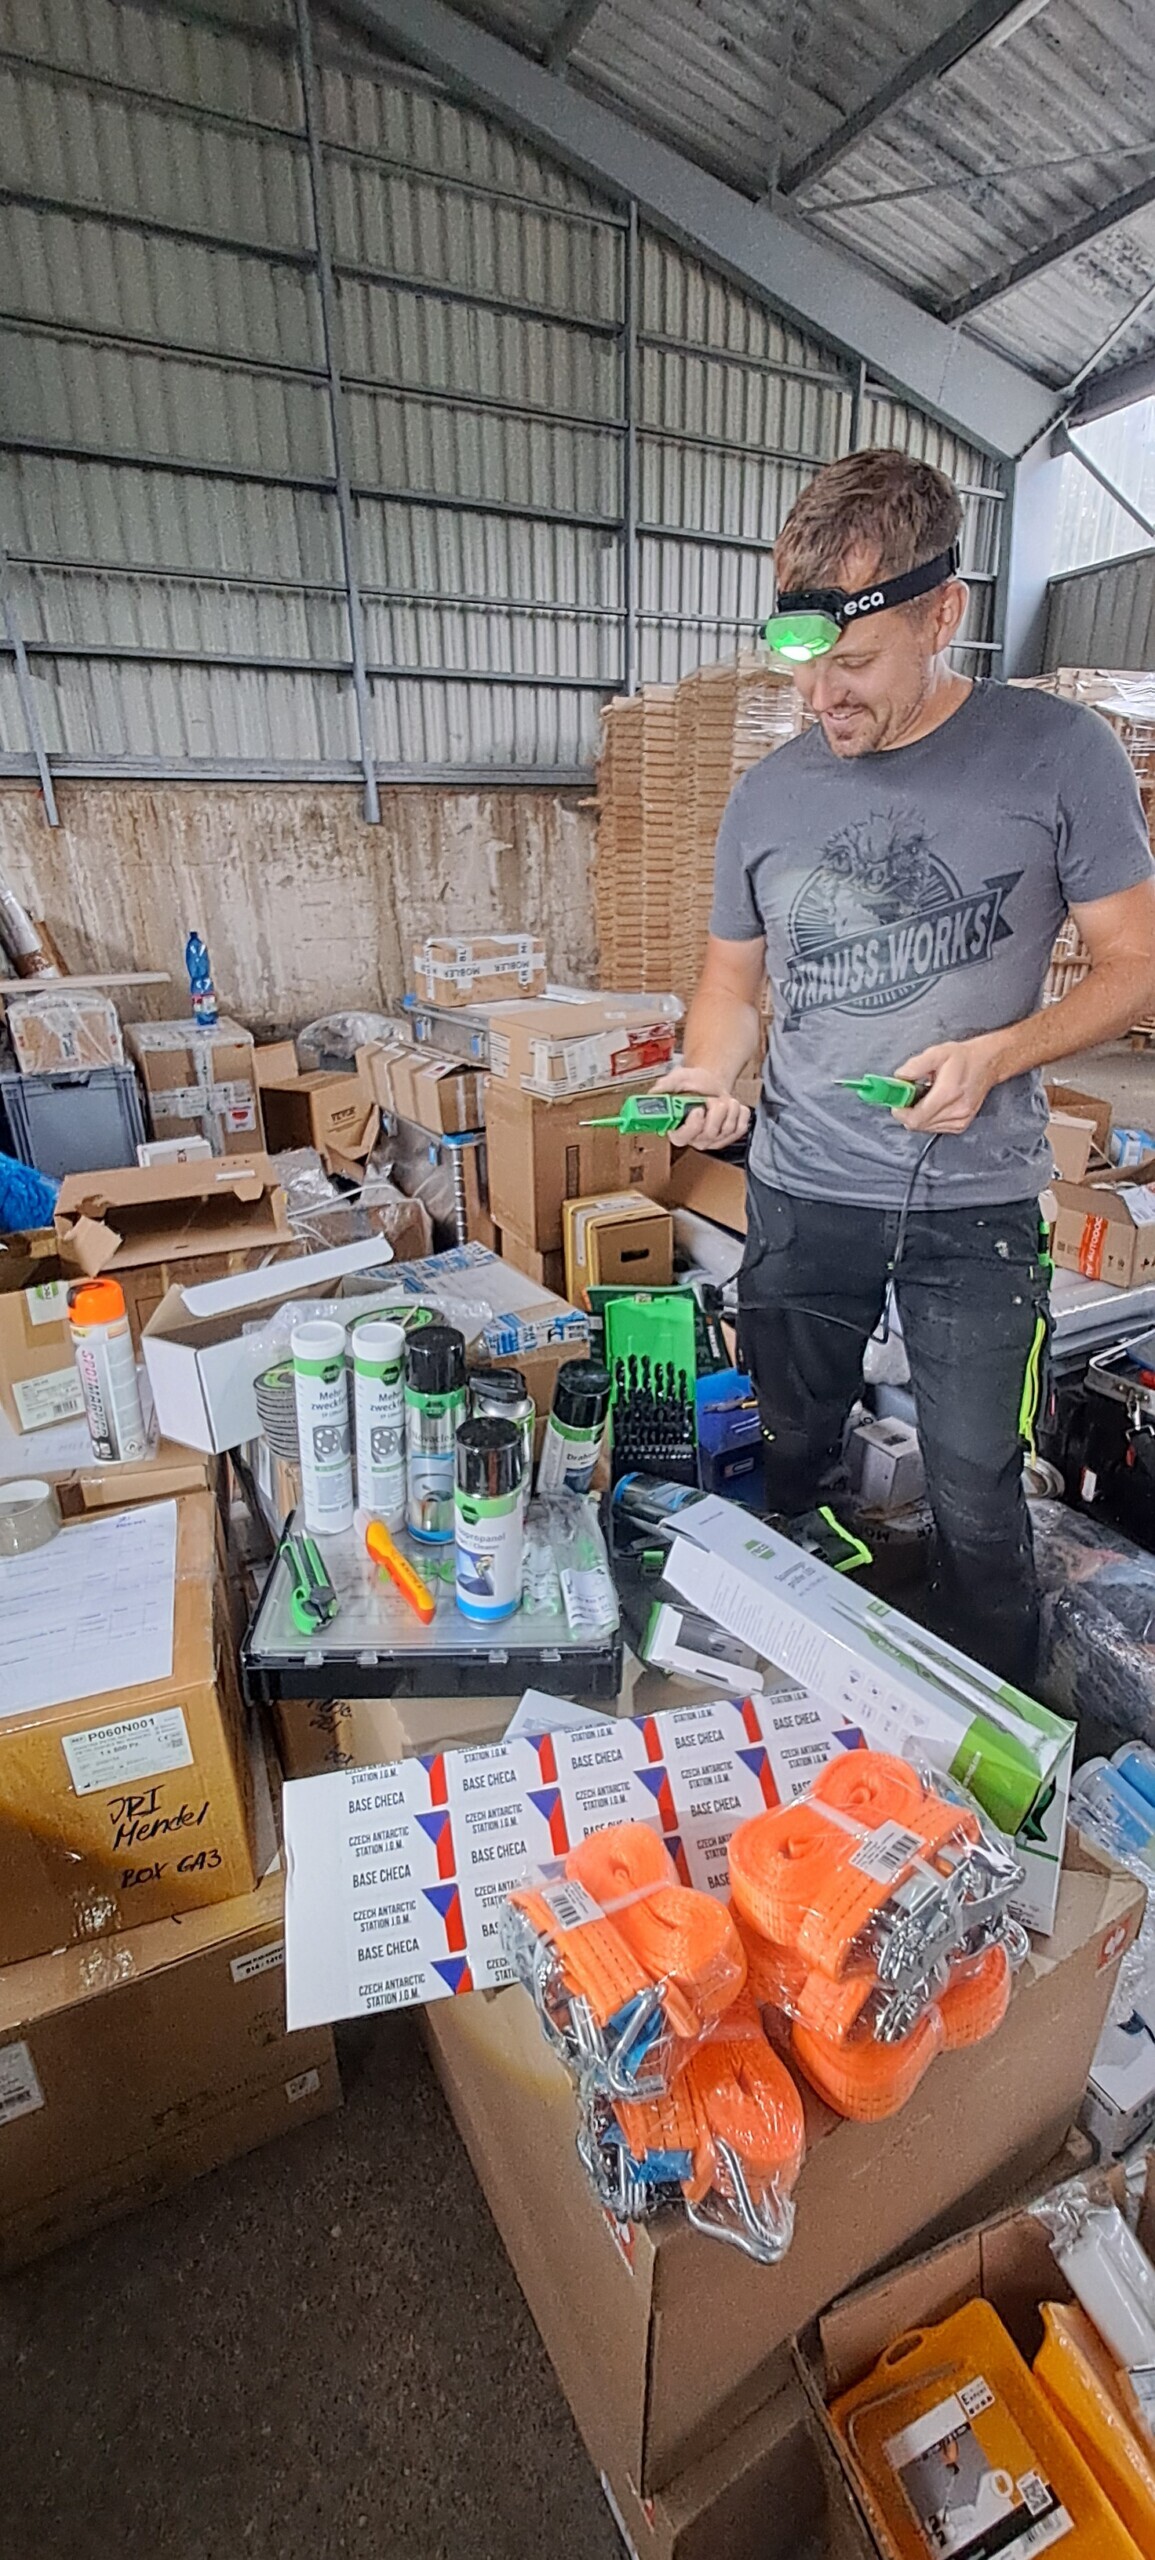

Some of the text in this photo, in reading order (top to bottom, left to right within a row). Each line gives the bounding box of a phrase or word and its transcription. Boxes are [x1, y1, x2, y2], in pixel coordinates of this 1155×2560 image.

[770, 1693, 792, 1705] STATION
[673, 1710, 697, 1723] STATION
[773, 1711, 821, 1731] BASE CHECA
[88, 1718, 155, 1742] P060N001
[571, 1730, 596, 1743] STATION
[675, 1729, 725, 1749] BASE CHECA
[464, 1750, 490, 1763] STATION
[571, 1749, 623, 1770] BASE CHECA
[788, 1756, 811, 1769] STATION
[351, 1772, 379, 1785] STATION
[463, 1770, 517, 1791] BASE CHECA
[681, 1766, 701, 1780] CZECH
[689, 1776, 714, 1790] STATION
[575, 1788, 596, 1801] CZECH
[349, 1791, 405, 1814] BASE CHECA
[583, 1798, 609, 1811] STATION
[691, 1796, 741, 1817] BASE CHECA
[465, 1803, 523, 1823] CZECH ANTARCTIC
[112, 1801, 210, 1852] Mendel
[472, 1821, 498, 1834] STATION
[349, 1825, 410, 1847] CZECH ANTARCTIC
[697, 1836, 718, 1850] CZECH
[355, 1843, 384, 1857] STATION
[471, 1840, 527, 1864] BASE CHECA
[705, 1847, 728, 1860] STATIO
[352, 1864, 411, 1888] BASE CHECA
[474, 1885, 497, 1897] CZECH
[353, 1900, 416, 1921] CZECH ANTARCTIC
[360, 1919, 389, 1932] STATION
[481, 1921, 499, 1937] BAS
[358, 1938, 420, 1962] BASE CHECA
[359, 1973, 425, 1996] CZECH ANTARCTIC
[366, 1994, 397, 2009] STATION
